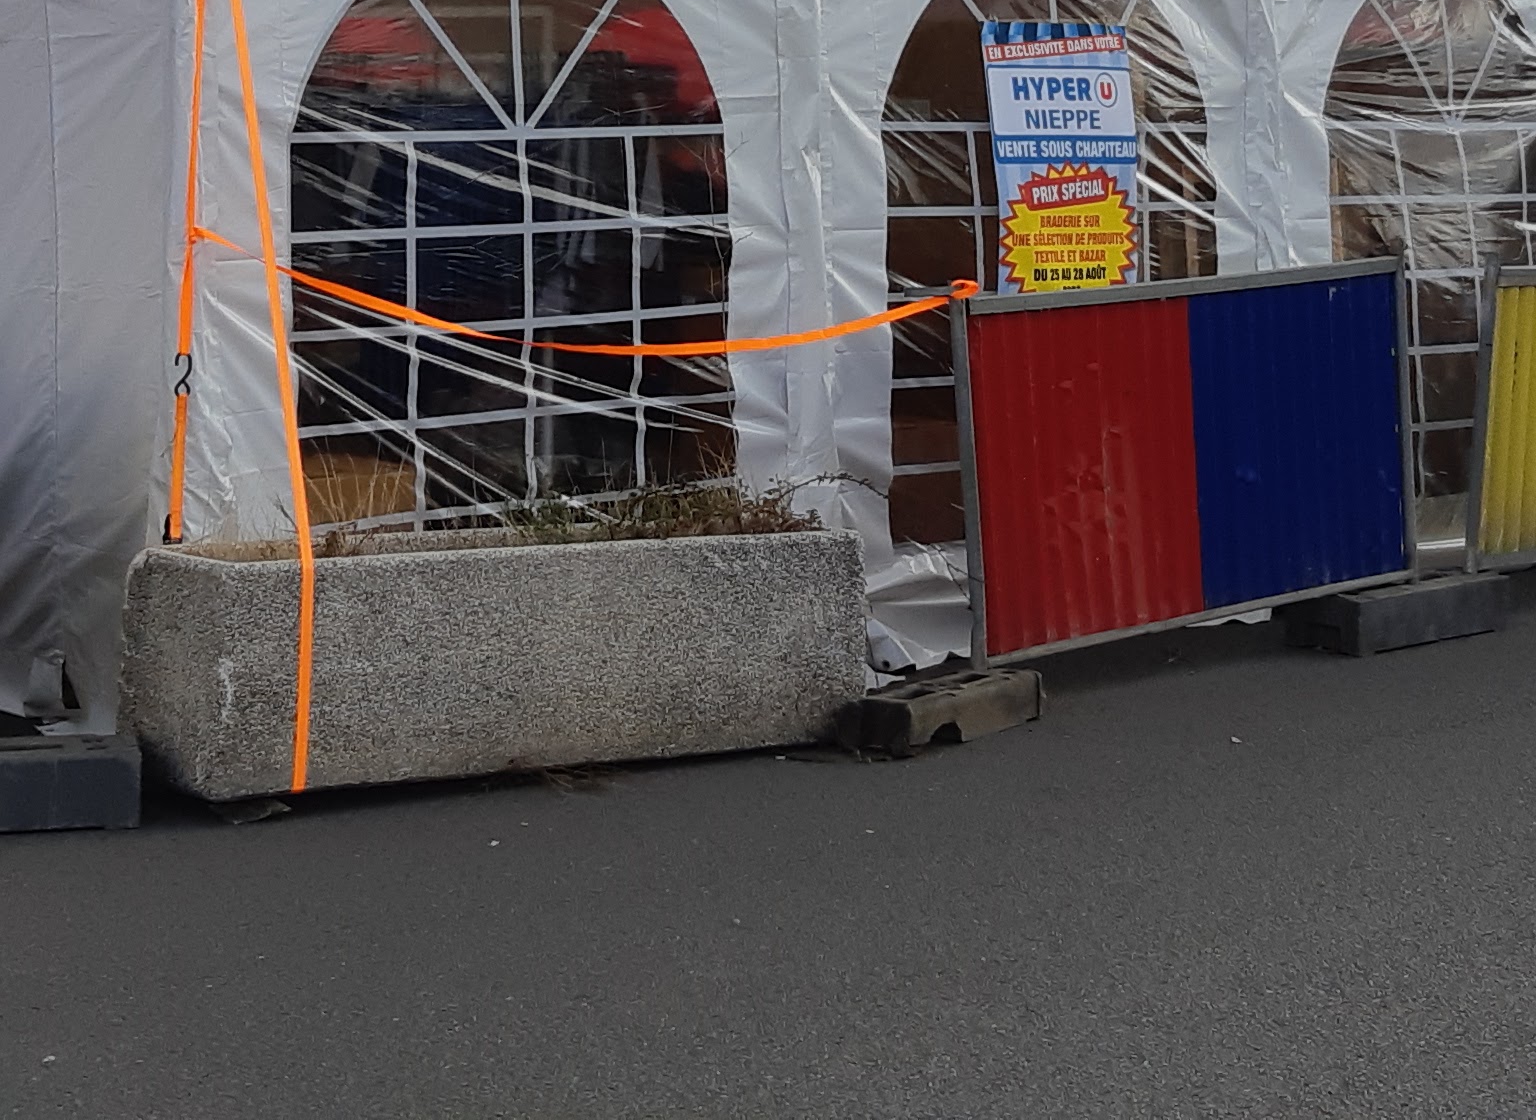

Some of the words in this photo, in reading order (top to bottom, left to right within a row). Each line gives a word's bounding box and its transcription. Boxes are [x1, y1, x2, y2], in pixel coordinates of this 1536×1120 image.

[988, 46, 1002, 60] EN
[1066, 37, 1094, 52] DANS
[1094, 36, 1121, 49] VOTRE
[1011, 76, 1092, 101] HYPER
[1099, 81, 1113, 101] U
[1024, 109, 1101, 130] NIEPPE
[996, 139, 1037, 158] VENTE
[1040, 140, 1073, 158] SOUS
[1075, 140, 1137, 159] CHAPITEAU
[1031, 184, 1060, 205] PRIX
[1061, 178, 1105, 200] SPÉCIAL
[1084, 214, 1101, 228] SUR
[1012, 233, 1031, 246] UNE
[1075, 233, 1086, 245] DE
[1087, 232, 1125, 245] PRODUITS
[1034, 250, 1066, 263] TEXTILE
[1067, 250, 1077, 262] ET
[1079, 249, 1106, 262] BAZAR
[1034, 268, 1048, 281] DU
[1050, 268, 1060, 281] 25
[1062, 268, 1072, 280] AU
[1073, 267, 1084, 280] 28
